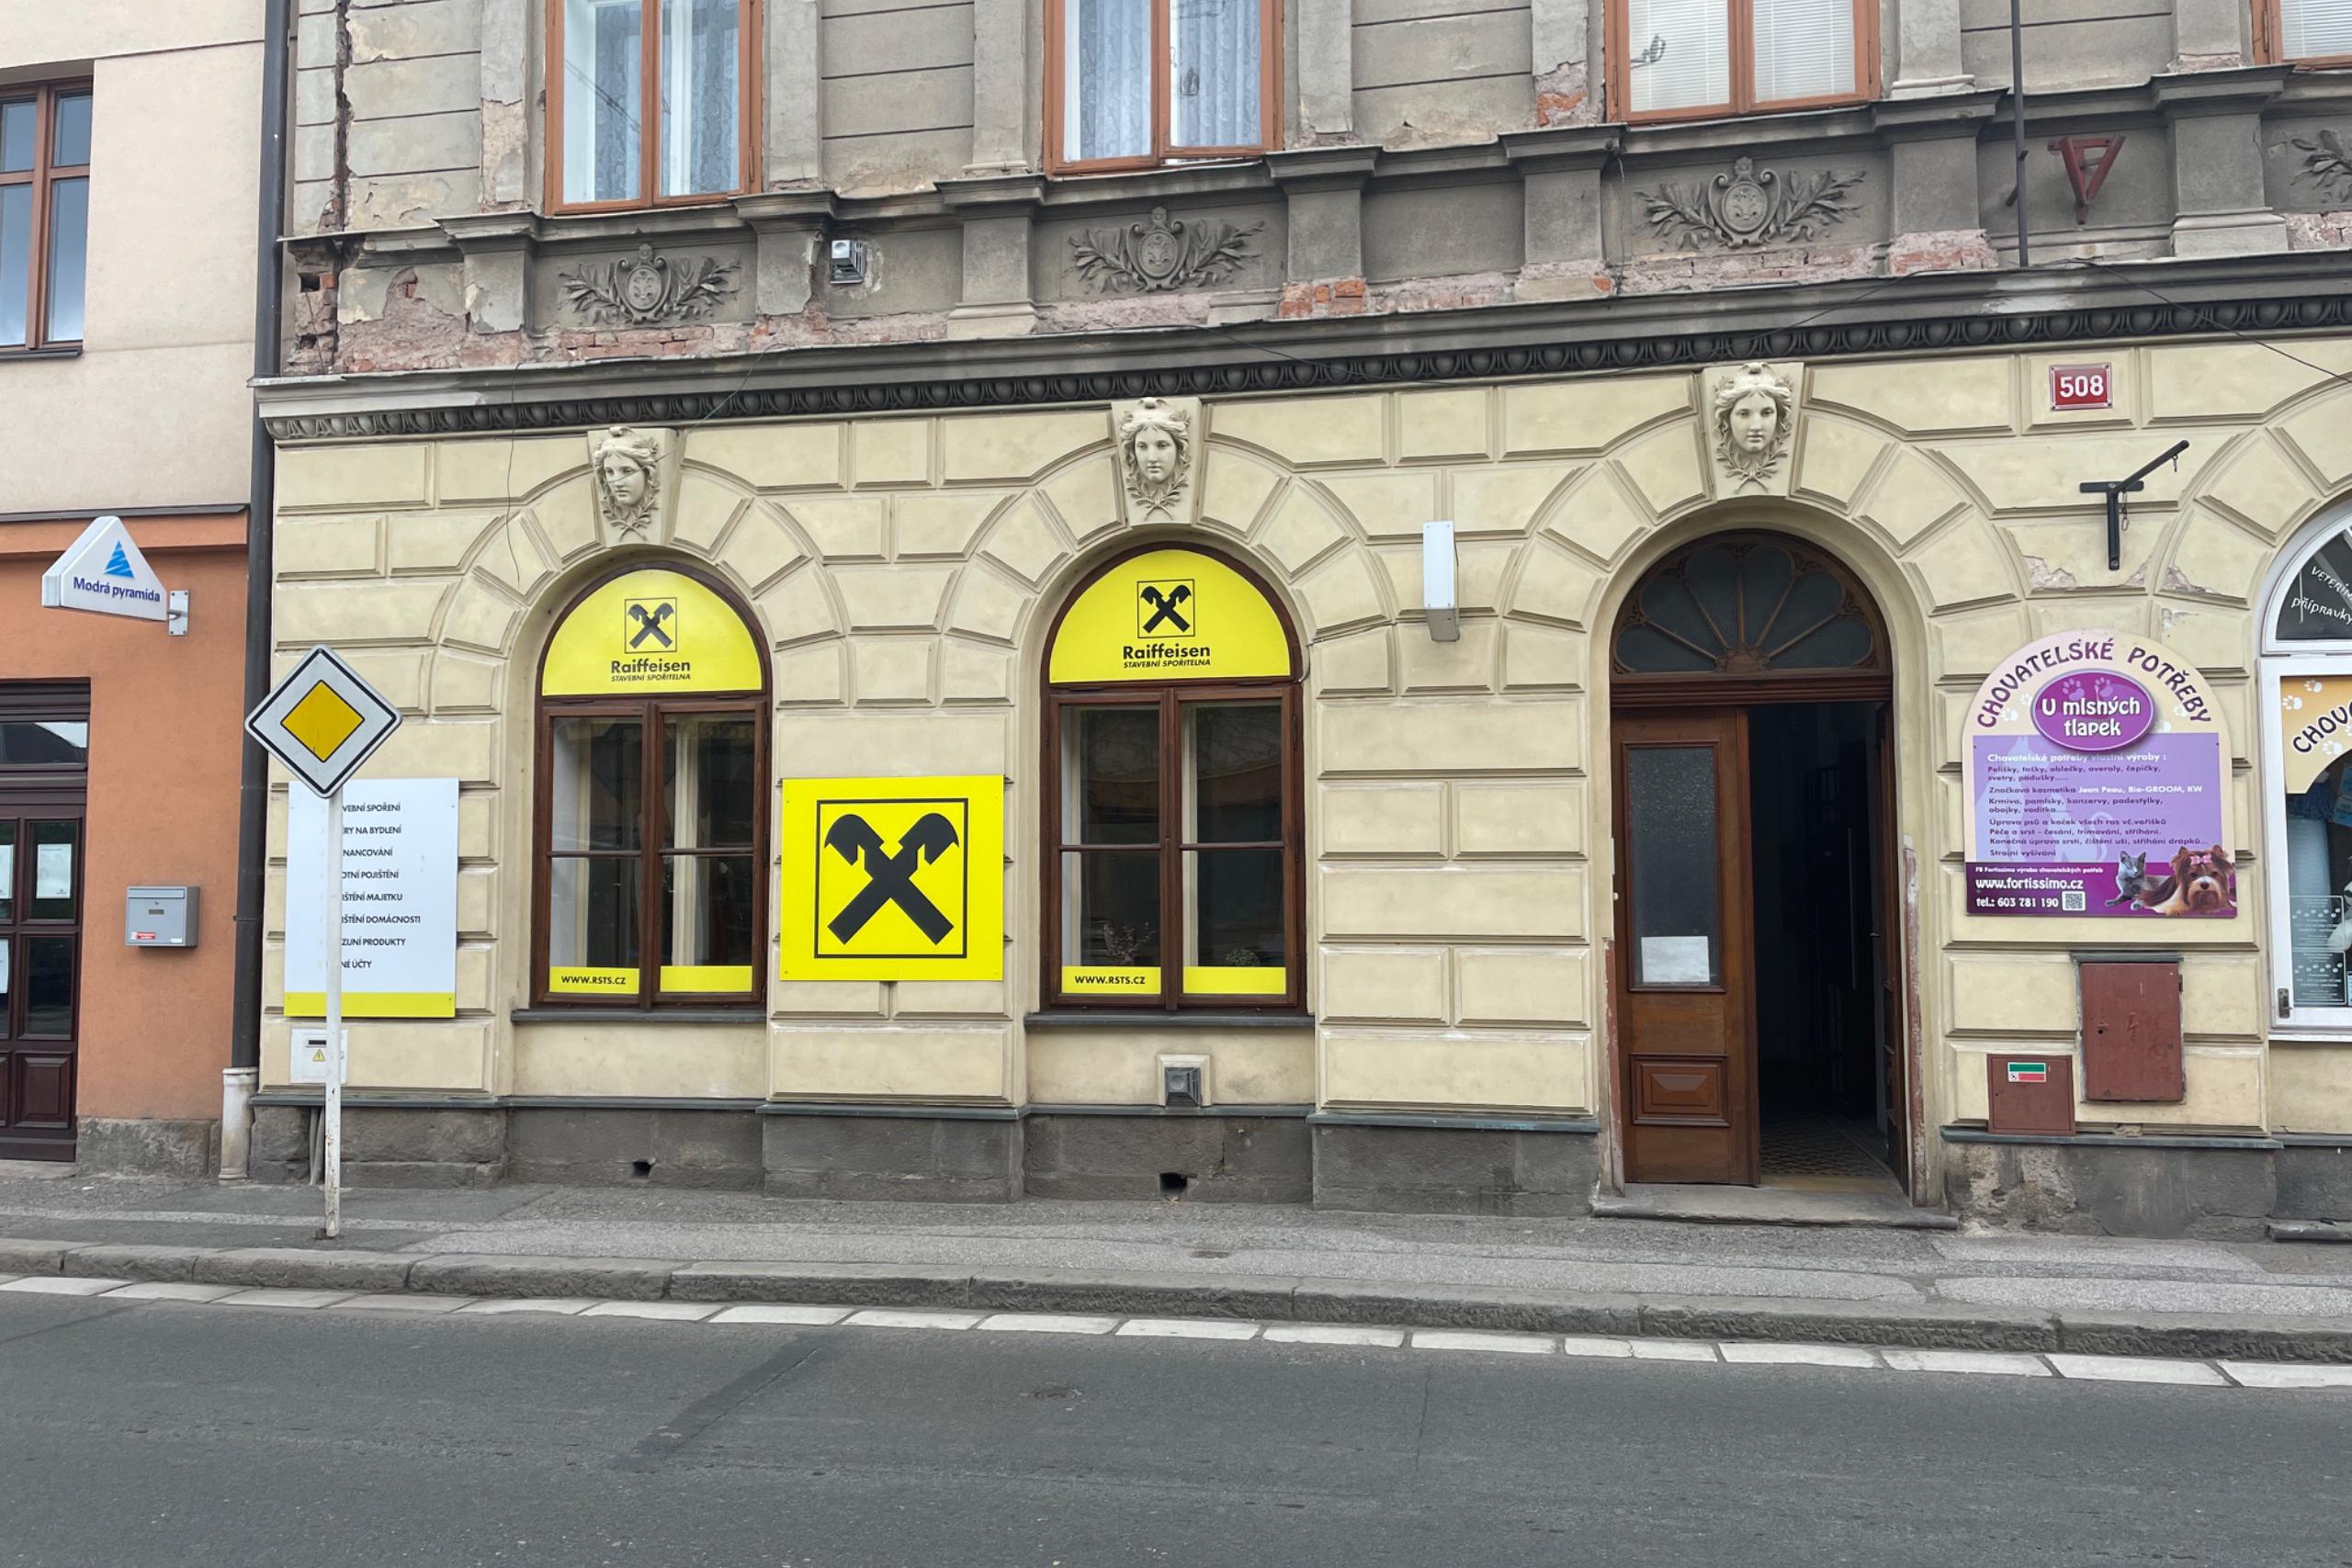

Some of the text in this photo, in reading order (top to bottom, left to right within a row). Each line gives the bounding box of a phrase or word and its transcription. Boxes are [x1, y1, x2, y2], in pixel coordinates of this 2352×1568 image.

[2060, 375, 2103, 398] 508
[74, 577, 160, 602] Modrá pyramida
[1123, 642, 1210, 660] Raiffeisen
[610, 658, 690, 674] Raiffeisen
[1124, 658, 1211, 669] STAVEBNÍ SPOŘITELNA
[611, 672, 691, 682] STAVEBNÍ SPOŘITELNA
[1977, 637, 2211, 728] CHOVATELSKÉ POTŘEBY
[2041, 696, 2141, 716] U mlsných
[2064, 718, 2121, 737] tlapek
[2293, 702, 2352, 752] CHOV
[1987, 753, 2047, 762] Chovatelské
[2050, 753, 2088, 763] potřeby
[2126, 752, 2160, 762] výroby
[367, 802, 401, 812] SPOŘENÍ
[369, 824, 401, 834] BYDLENÍ
[361, 868, 399, 879] POJIŠTĚNÍ
[1975, 877, 2084, 890] www.fortissimo.cz
[367, 893, 402, 901] MAJETKU
[1976, 897, 2059, 908] tel.: 603 781 190
[366, 914, 421, 923] DOMÁCNOSTI
[363, 938, 406, 946] PRODUKTY
[353, 958, 372, 968] ÚČTY
[560, 976, 626, 986] WWW.RSTS.CZ
[1074, 975, 1146, 985] WWW.RSTS.CZ
